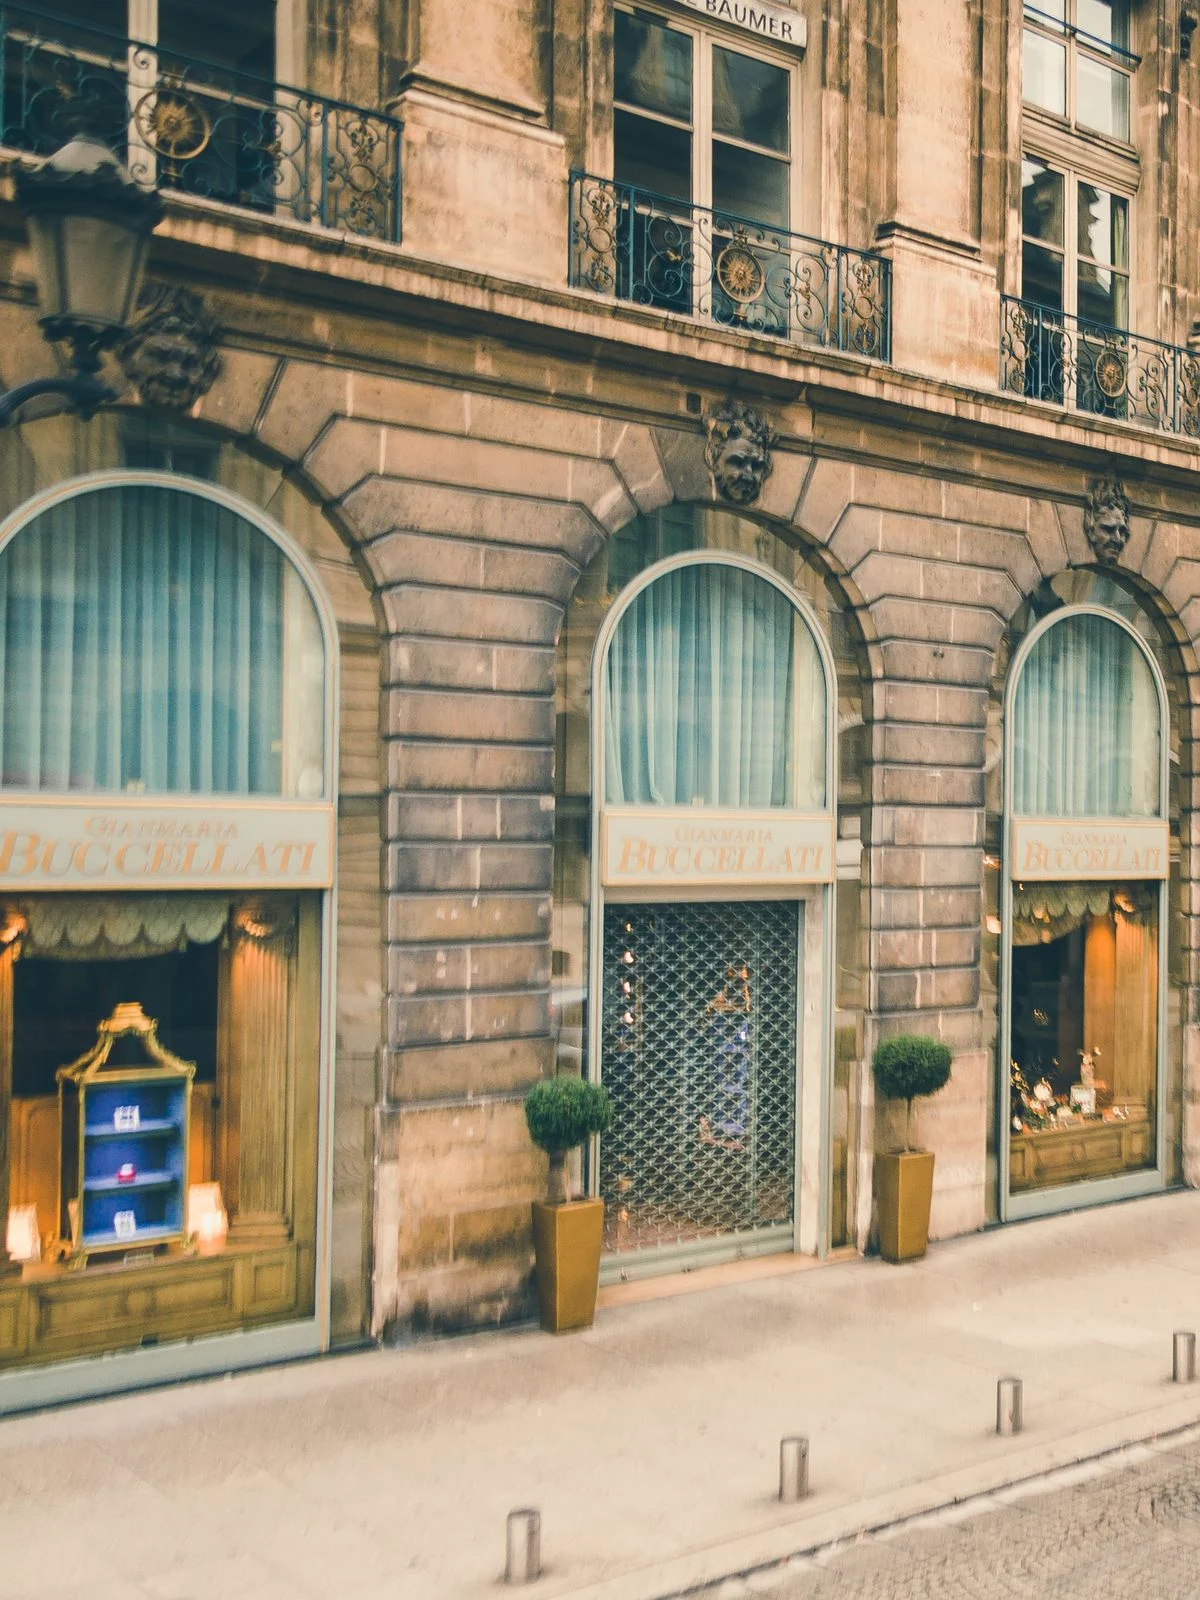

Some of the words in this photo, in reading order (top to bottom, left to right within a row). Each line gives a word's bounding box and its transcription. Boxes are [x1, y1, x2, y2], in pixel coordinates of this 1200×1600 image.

[705, 0, 793, 41] BAUMER
[0, 829, 317, 877] BUCCELLATI
[616, 834, 825, 874] BUCCELLATI
[674, 824, 776, 844] GIANMARIA
[1022, 839, 1161, 872] BUCCELLATI
